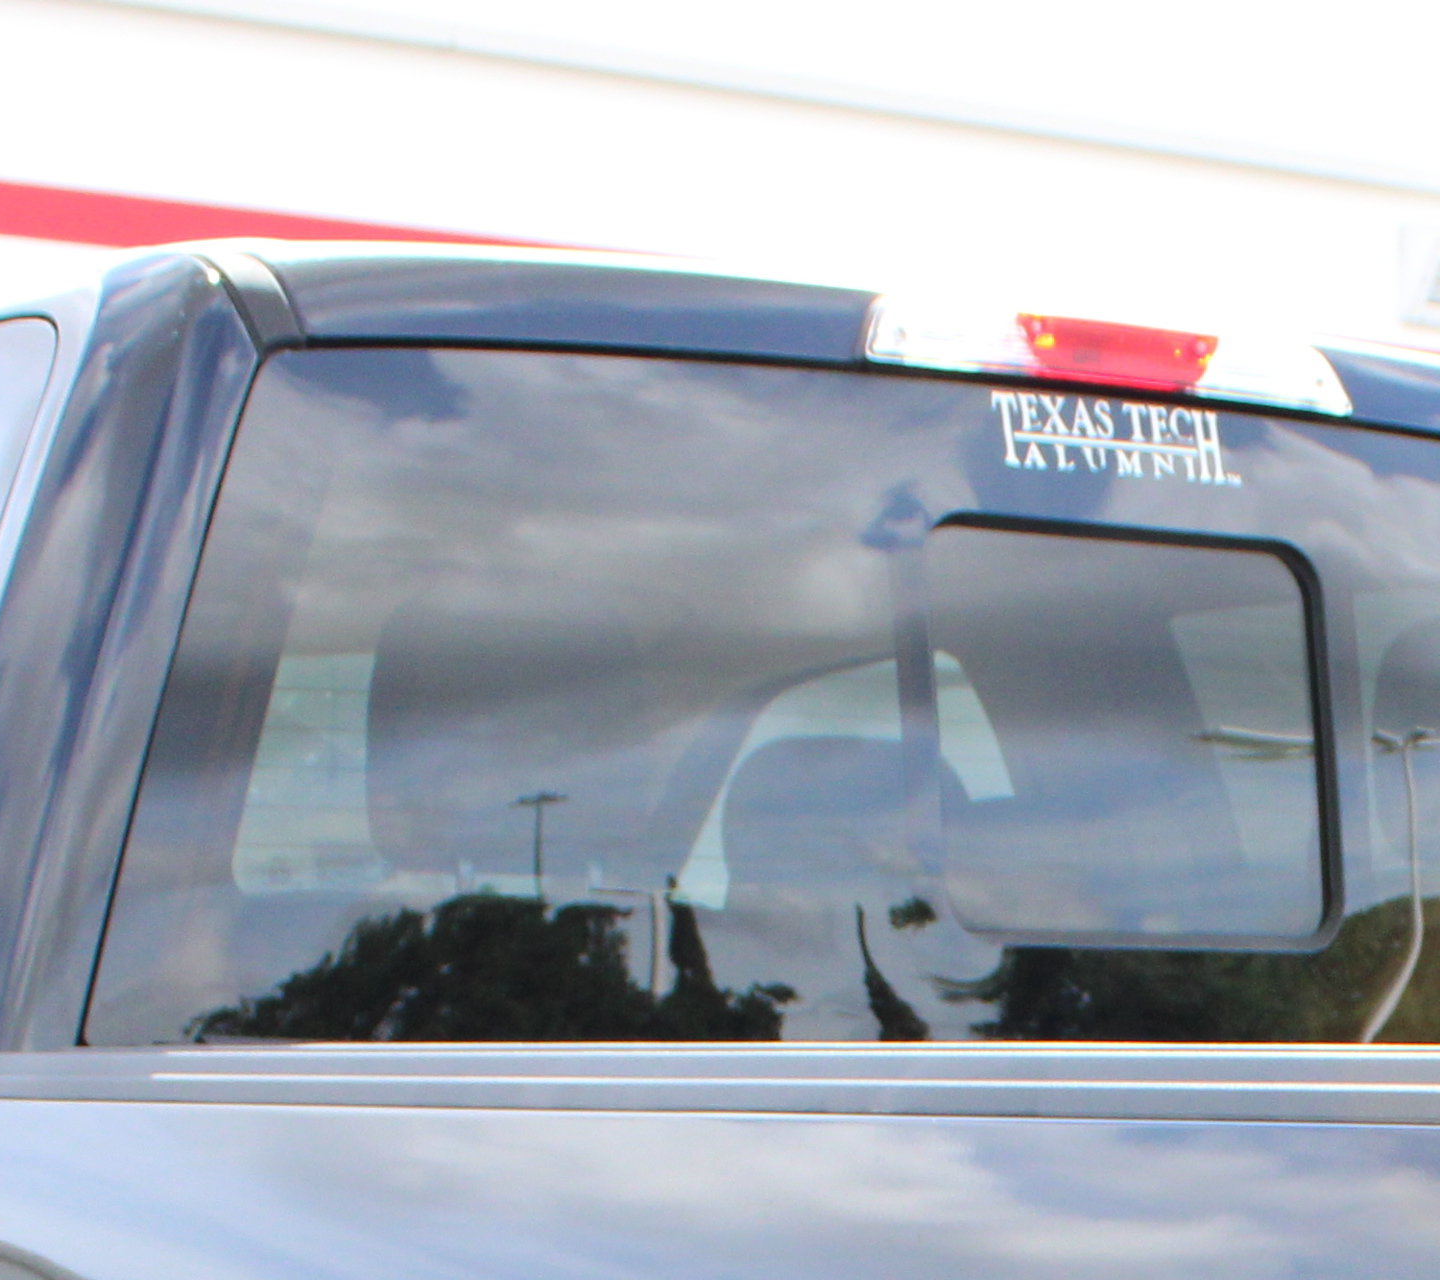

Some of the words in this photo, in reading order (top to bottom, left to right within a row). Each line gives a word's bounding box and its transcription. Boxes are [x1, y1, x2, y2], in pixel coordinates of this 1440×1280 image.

[991, 390, 1114, 469] TEXAS
[1122, 402, 1226, 486] TECH
[1023, 441, 1197, 482] ALUMNI
